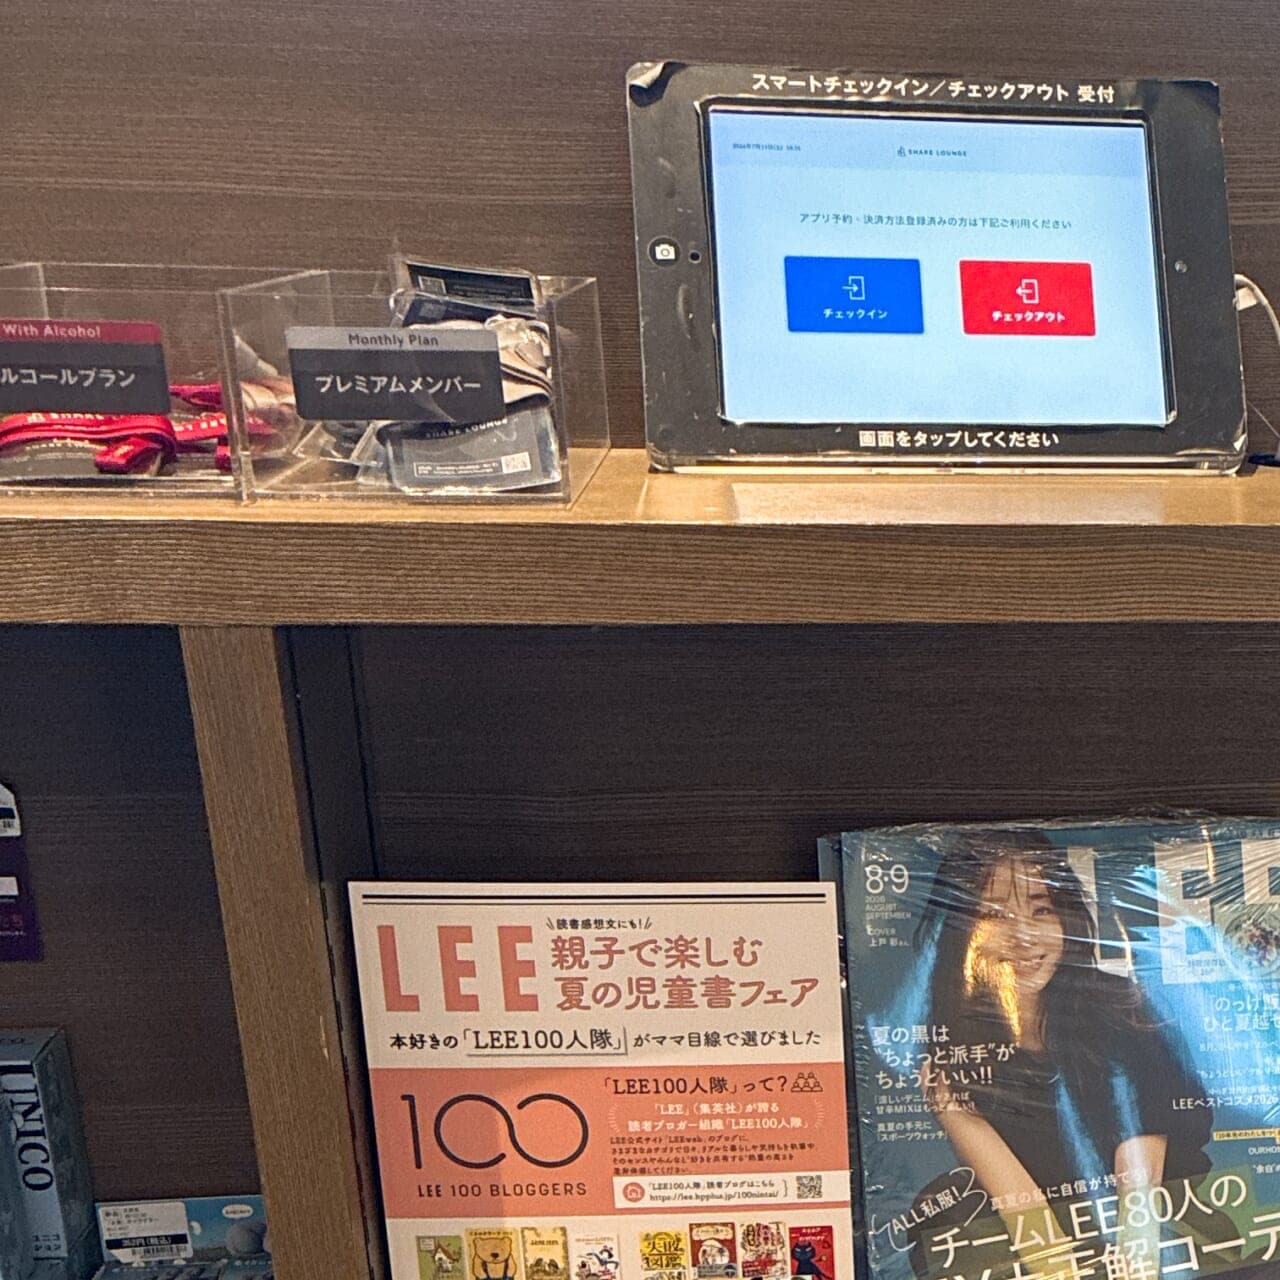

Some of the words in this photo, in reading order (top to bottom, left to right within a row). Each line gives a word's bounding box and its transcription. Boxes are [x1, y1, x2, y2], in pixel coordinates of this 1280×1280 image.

[1078, 85, 1115, 104] 受付
[822, 306, 888, 320] チェックイン
[992, 310, 1065, 323] チェックアウト
[3, 324, 38, 337] With
[44, 325, 100, 338] Alcohol
[349, 334, 402, 347] Monthly
[409, 334, 439, 346] Plan
[315, 376, 481, 393] プレミアムメンバー
[859, 429, 1060, 448] 画面をタップしてください
[551, 935, 763, 970] 親子で楽しむ
[377, 925, 539, 1013] LEE
[554, 975, 820, 1012] 夏の児童書フェア
[872, 1025, 950, 1046] 夏の黒は
[418, 1183, 442, 1198] LEE
[450, 1183, 483, 1197] 100
[490, 1182, 588, 1197] BLOGGERS
[930, 1175, 1247, 1268] チームLEE80人の
